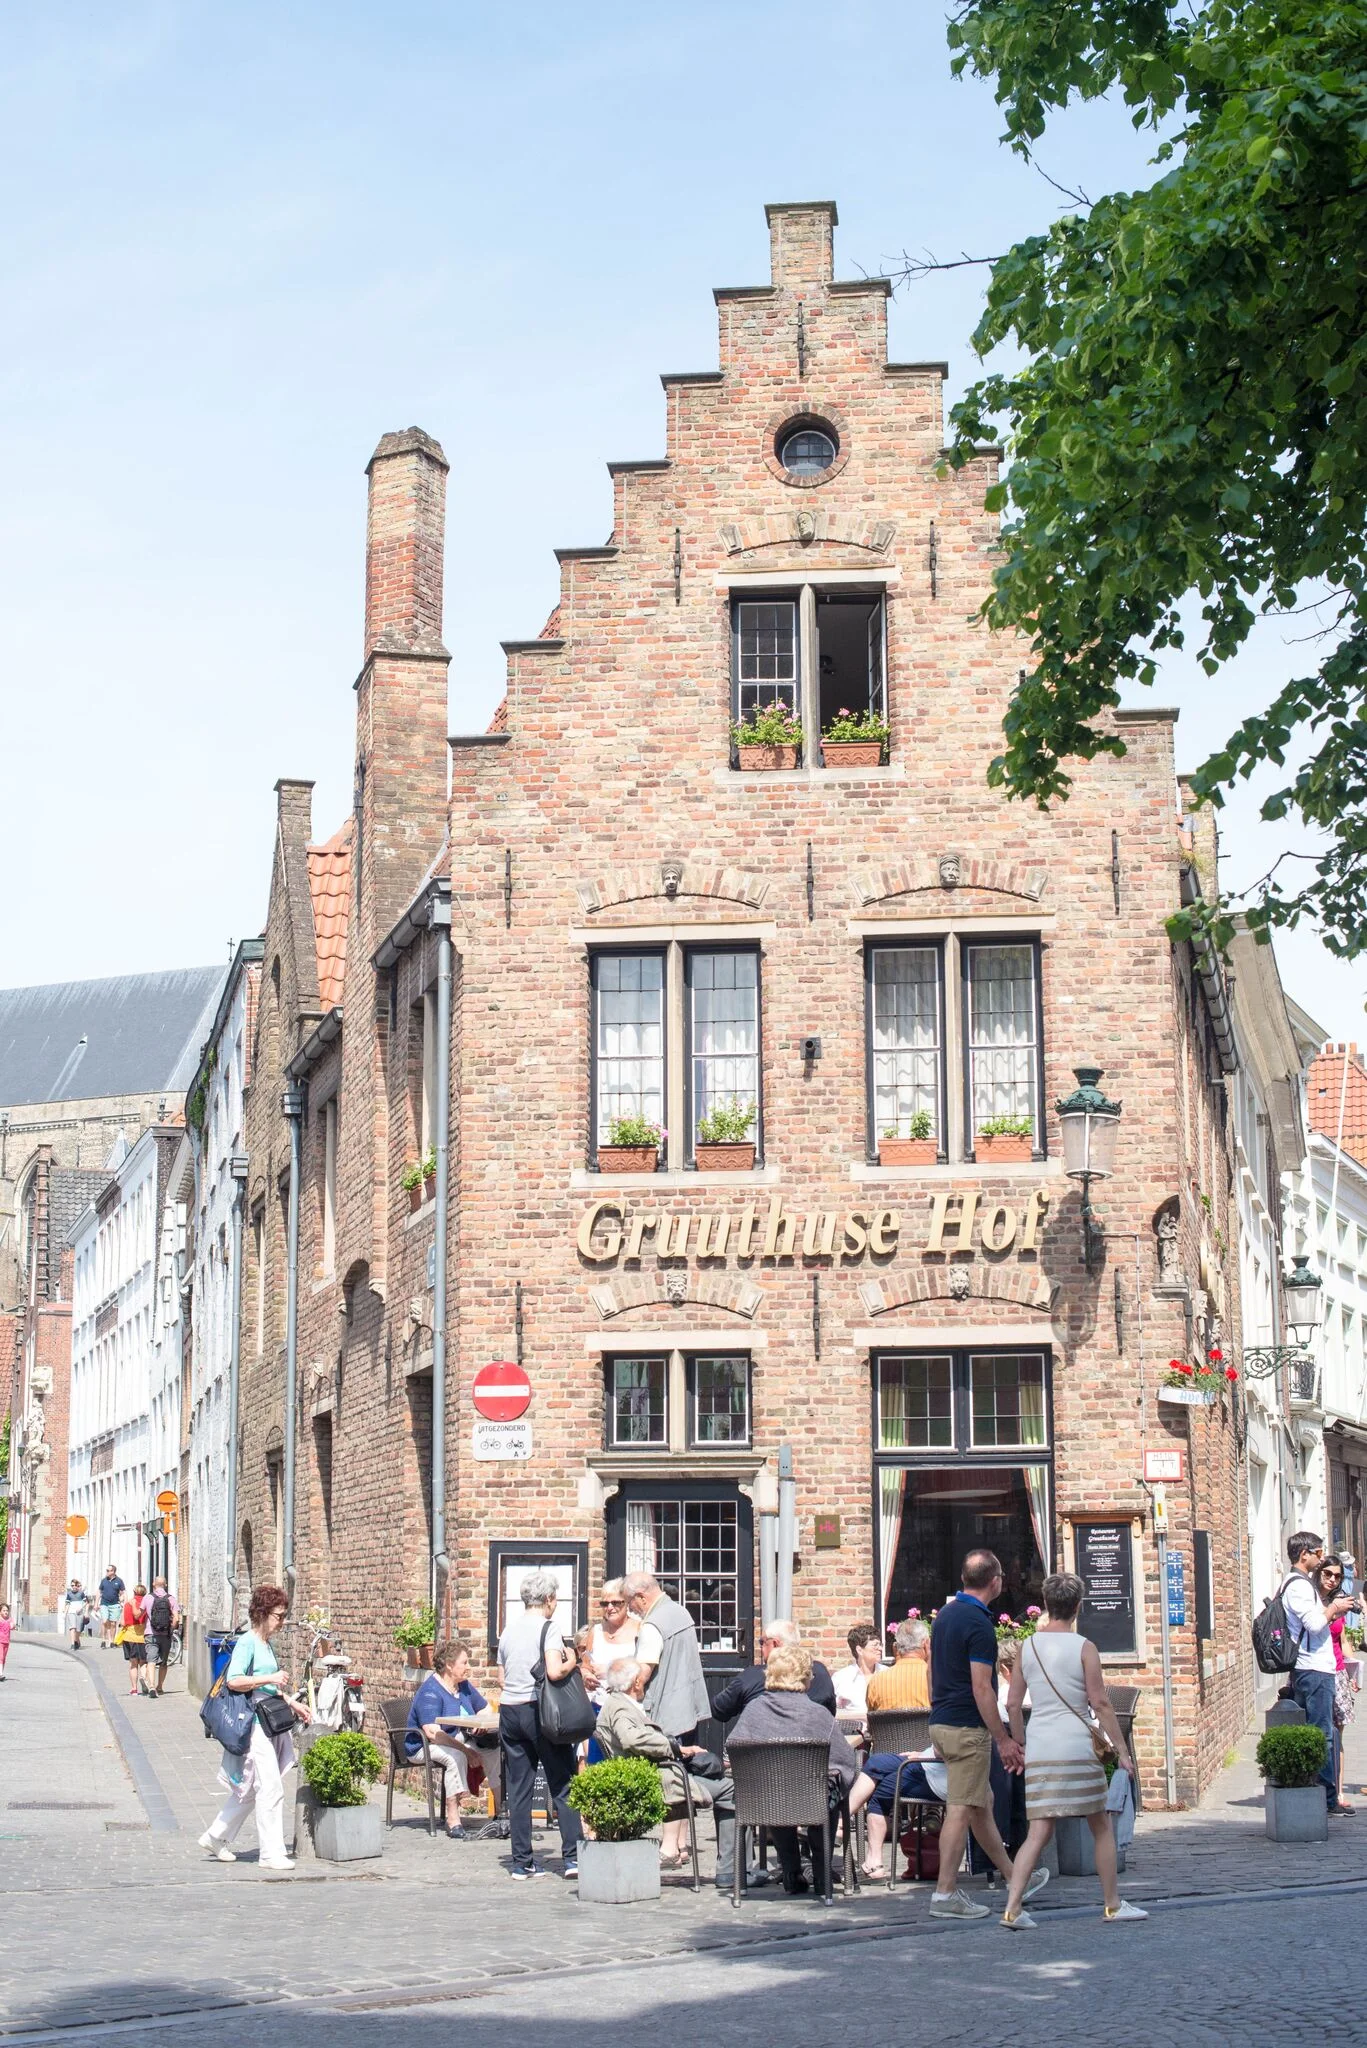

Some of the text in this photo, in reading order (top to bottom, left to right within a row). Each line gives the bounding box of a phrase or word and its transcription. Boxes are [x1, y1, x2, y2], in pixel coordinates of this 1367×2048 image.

[577, 1189, 1050, 1260] Gruuthuse Hof
[478, 1424, 526, 1434] UITGEZONDERD
